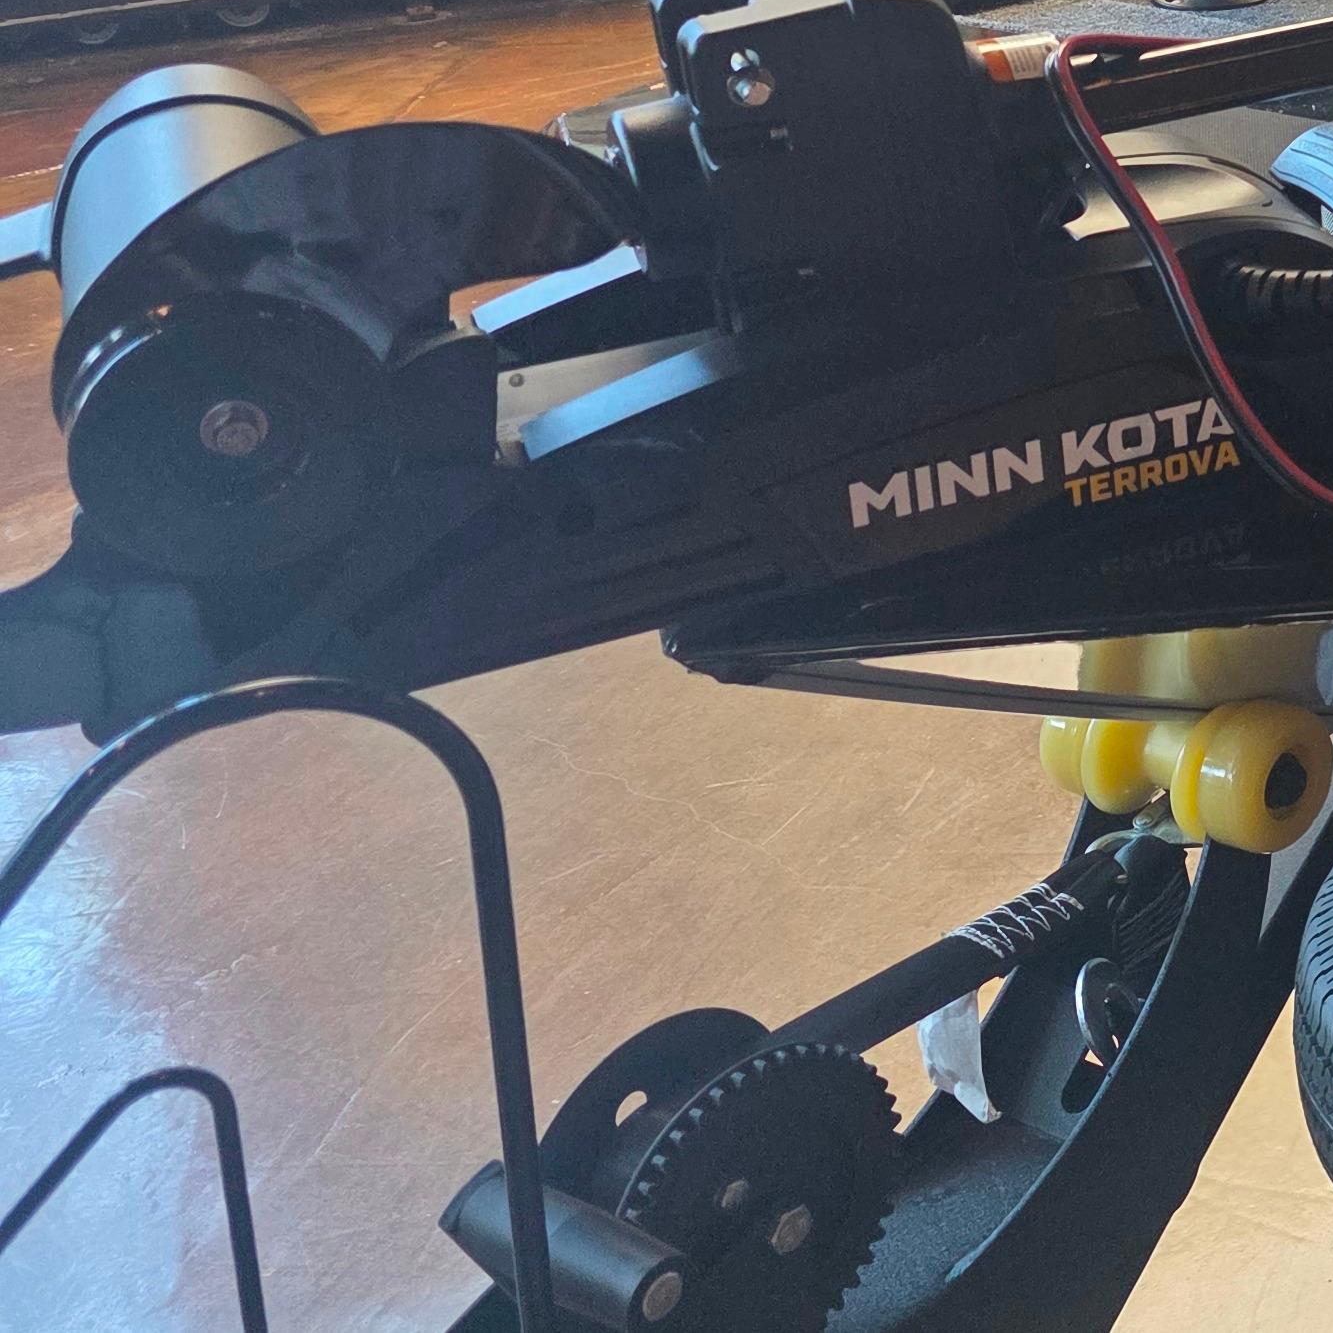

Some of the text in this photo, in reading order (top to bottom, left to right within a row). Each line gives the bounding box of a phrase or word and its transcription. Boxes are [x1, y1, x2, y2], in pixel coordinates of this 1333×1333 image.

[848, 397, 1235, 528] MINN KOTA
[1064, 440, 1241, 507] TERROVA
